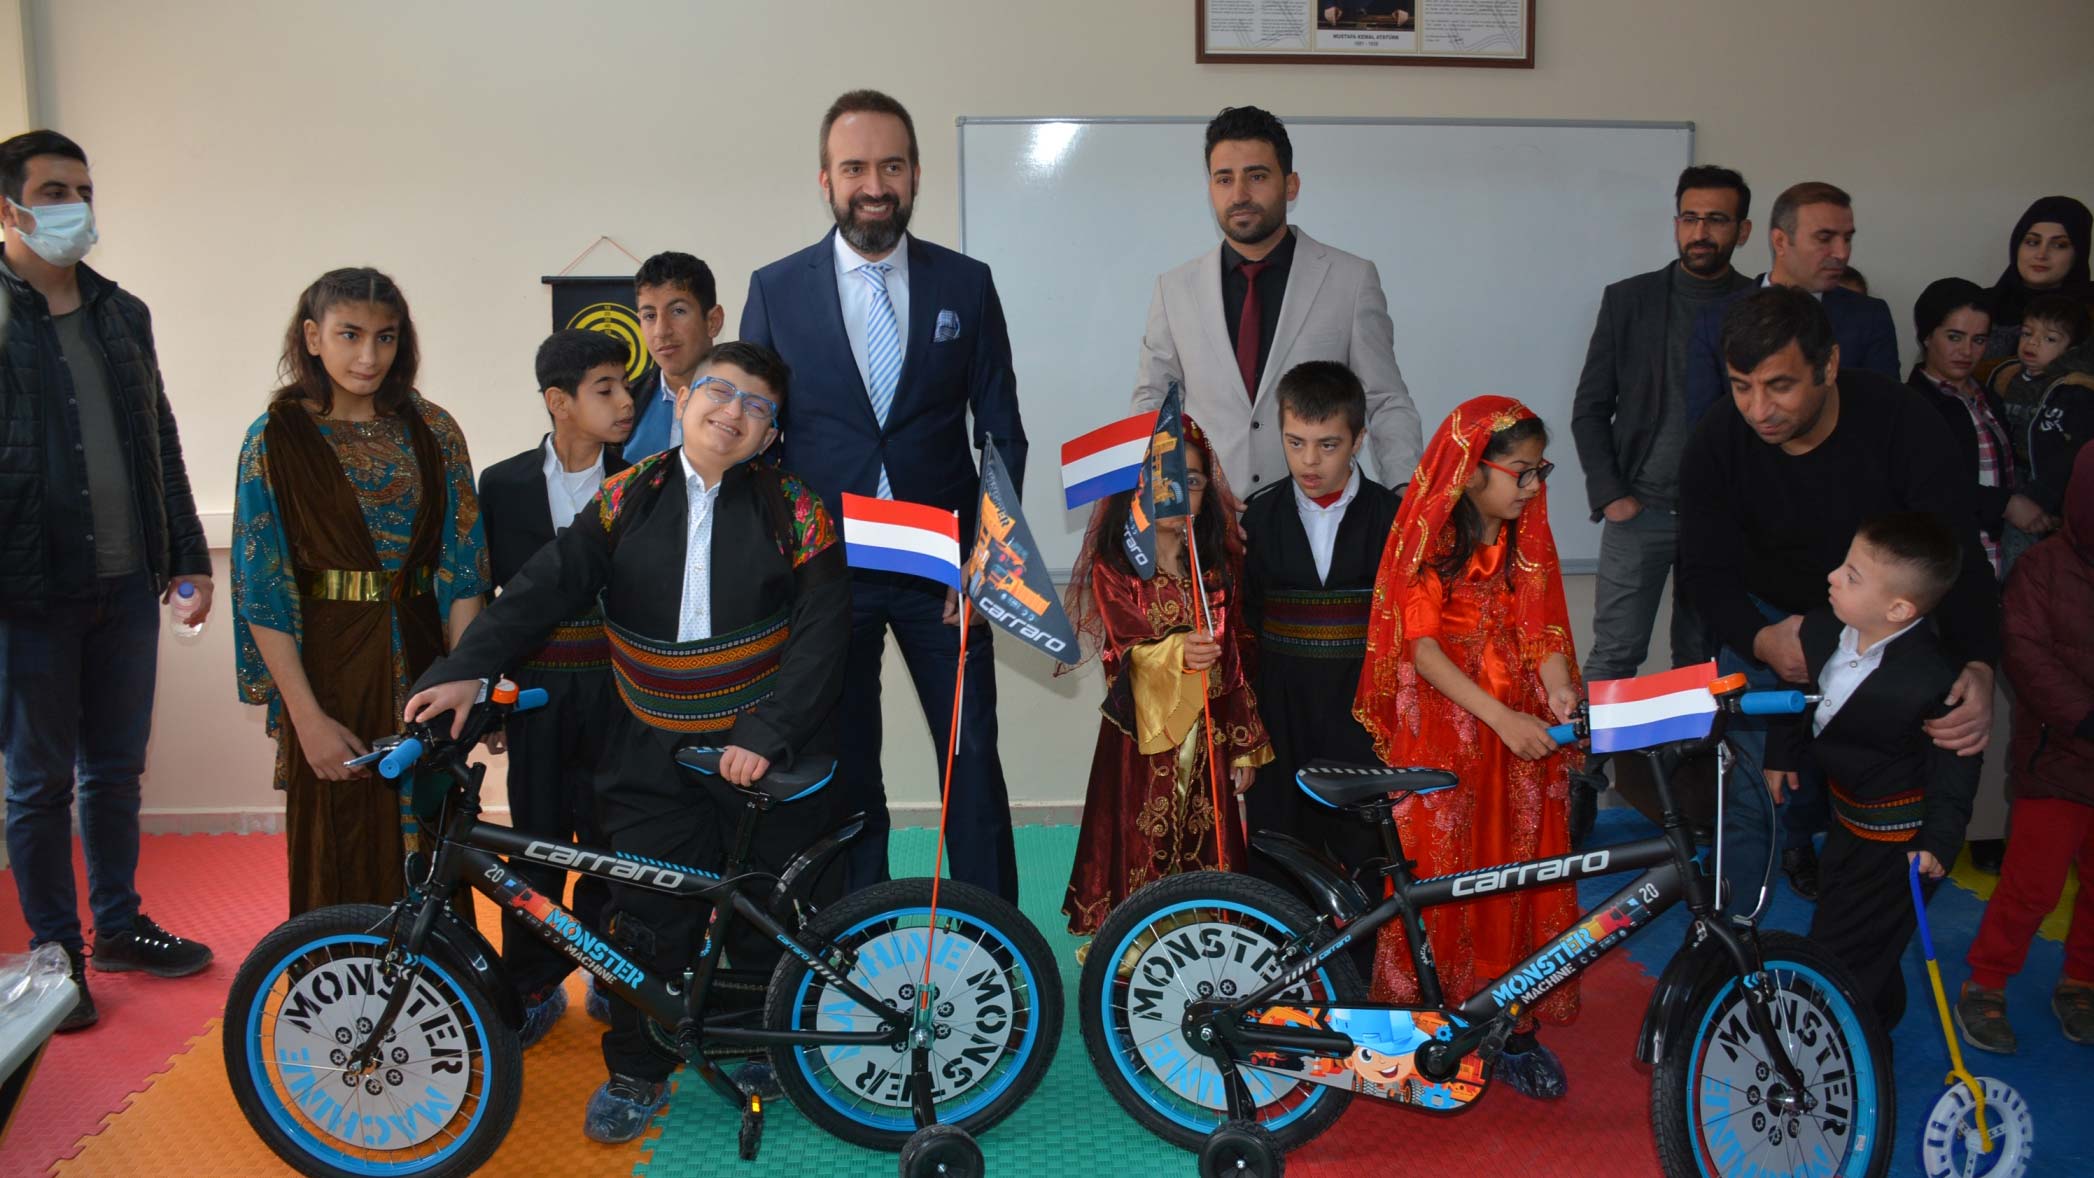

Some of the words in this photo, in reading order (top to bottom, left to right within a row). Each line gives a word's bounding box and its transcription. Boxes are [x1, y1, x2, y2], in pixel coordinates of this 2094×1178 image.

[979, 597, 1066, 652] carraro
[484, 864, 505, 883] 20
[525, 841, 685, 889] carraro
[1452, 850, 1610, 897] carraro
[1638, 883, 1660, 904] 20
[544, 908, 645, 990] MONSTER
[564, 943, 618, 985] MACHINE
[1318, 934, 1352, 961] carraro
[1491, 927, 1596, 1008] MONSTER
[1521, 963, 1577, 1005] MACHINE
[279, 1047, 454, 1146] MACHINE
